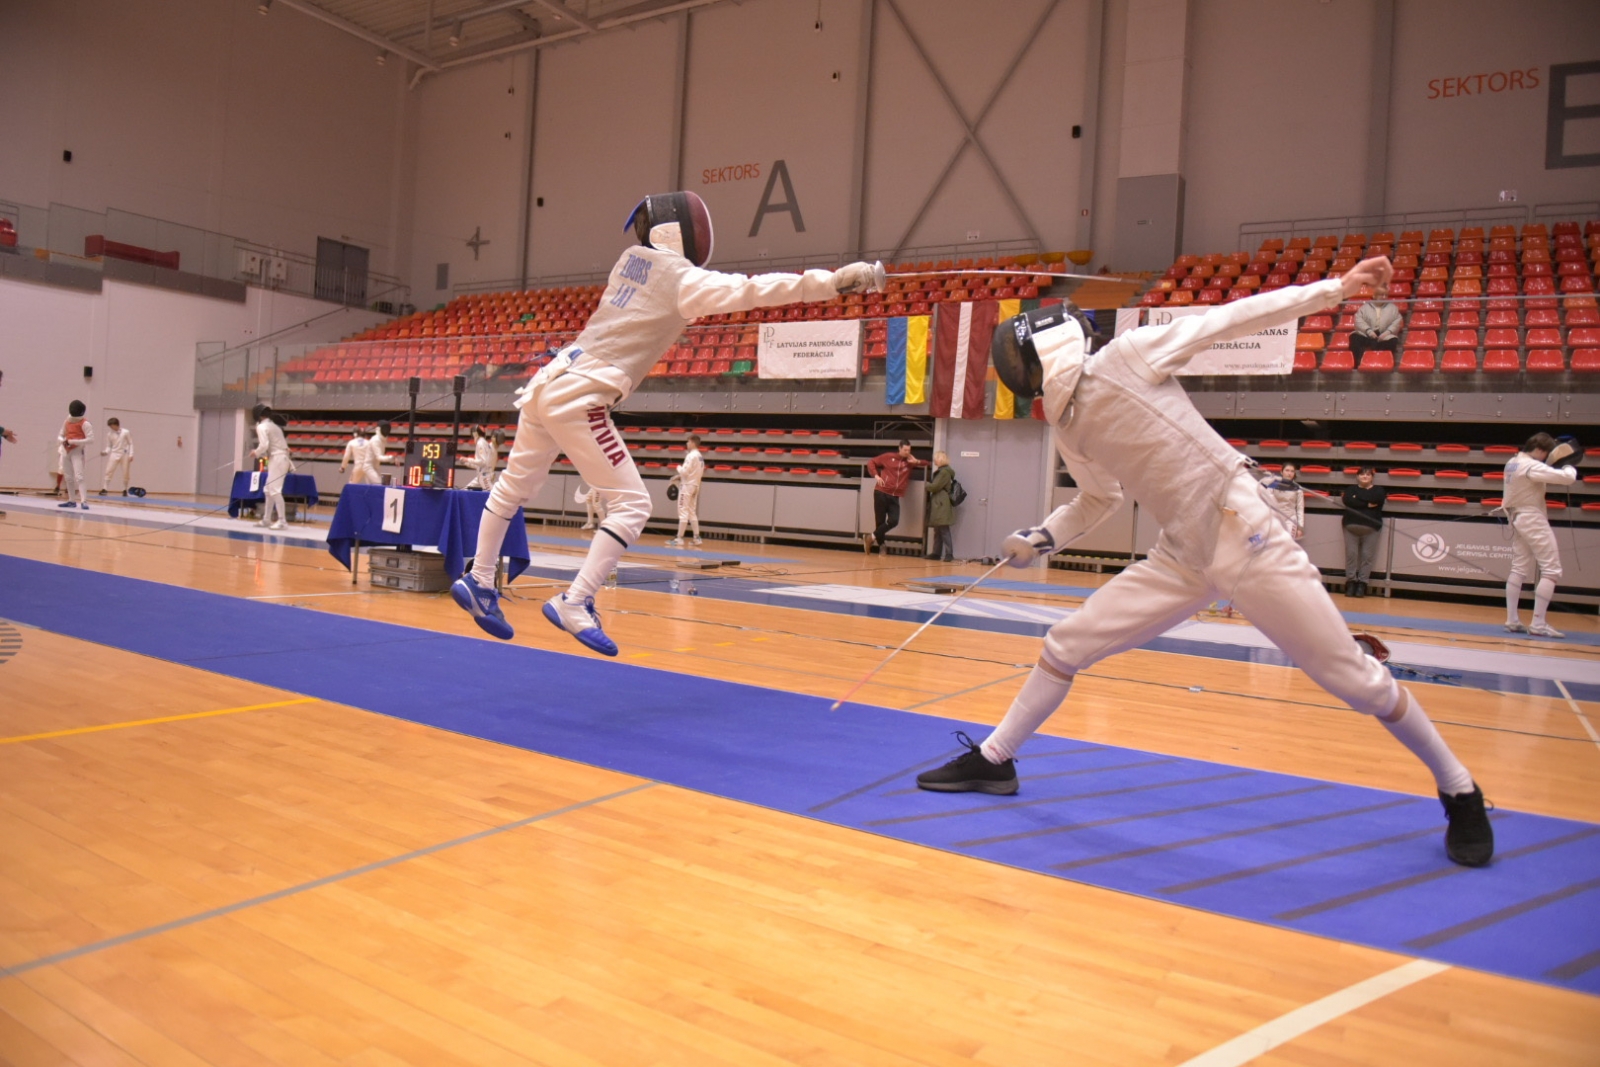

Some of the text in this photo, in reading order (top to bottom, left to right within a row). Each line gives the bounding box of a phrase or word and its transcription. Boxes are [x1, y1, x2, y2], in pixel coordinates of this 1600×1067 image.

[1427, 68, 1540, 99] SEKTORS
[702, 163, 760, 184] SEKTORS
[747, 159, 806, 237] A
[776, 340, 807, 348] LATVIJAS
[408, 465, 421, 487] 10
[447, 468, 453, 488] 1
[390, 498, 398, 523] 1
[1455, 543, 1490, 551] JELGAVAS
[1456, 550, 1488, 558] SERVISA
